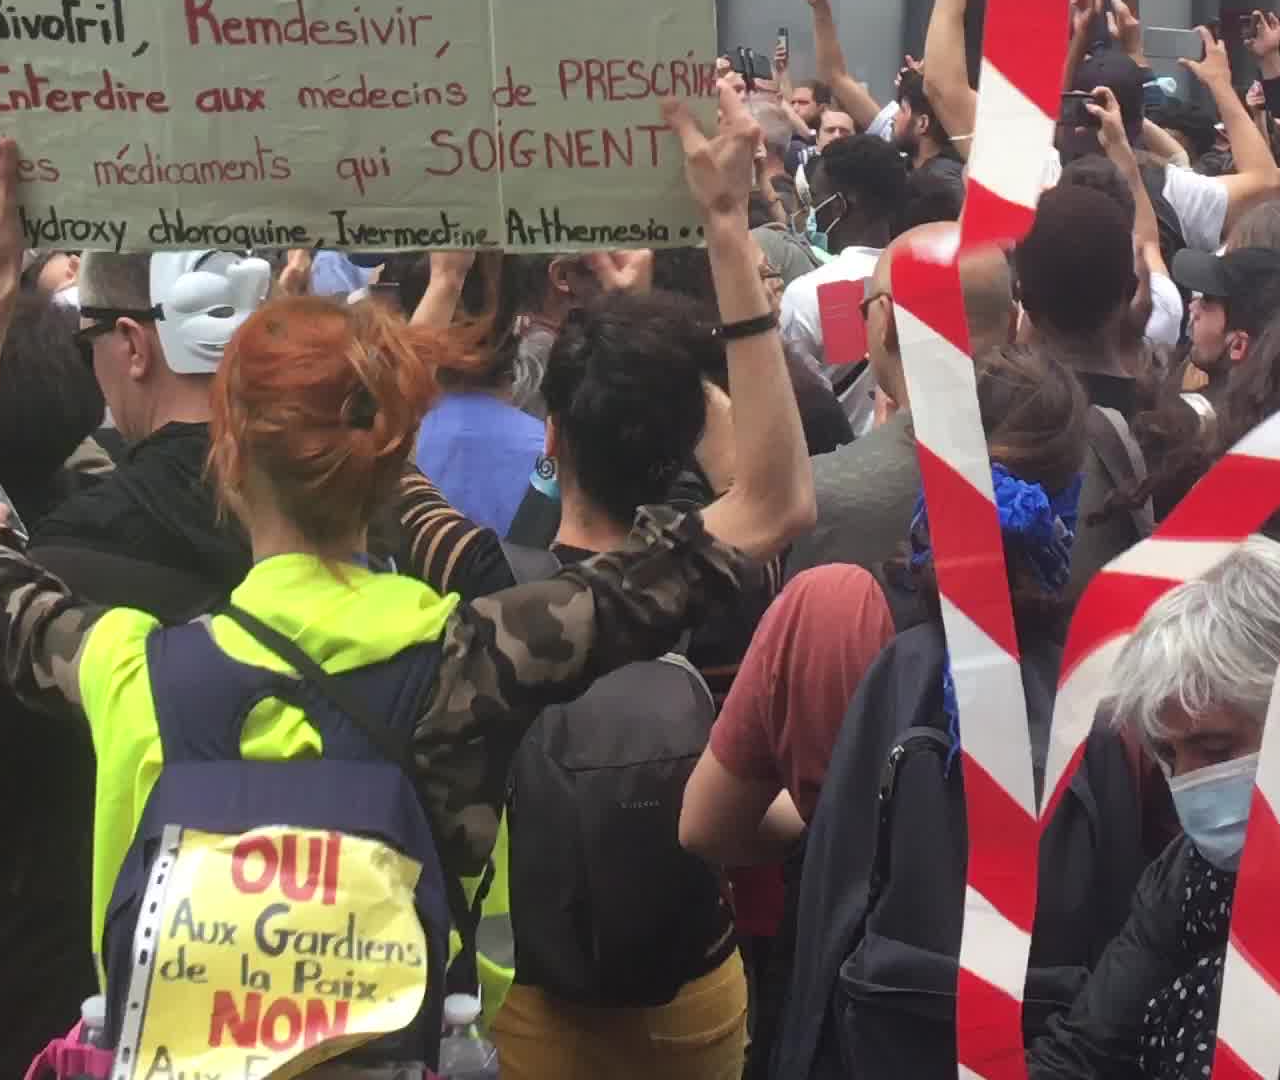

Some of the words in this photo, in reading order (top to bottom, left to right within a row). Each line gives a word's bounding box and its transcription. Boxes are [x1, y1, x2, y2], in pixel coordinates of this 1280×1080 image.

[195, 86, 268, 113] aux
[297, 73, 469, 110] médecins
[491, 65, 537, 109] de
[558, 50, 720, 103] PRESCRIR
[93, 135, 292, 188] médicaments
[335, 145, 392, 198] qui
[424, 120, 674, 177] SOIGNENT
[329, 209, 498, 249] Ivermectine
[231, 831, 342, 905] OUI
[170, 897, 238, 946] Aux
[254, 902, 423, 968] Gardiens
[159, 943, 208, 984] de
[240, 953, 271, 993] la
[208, 990, 350, 1052] NON
